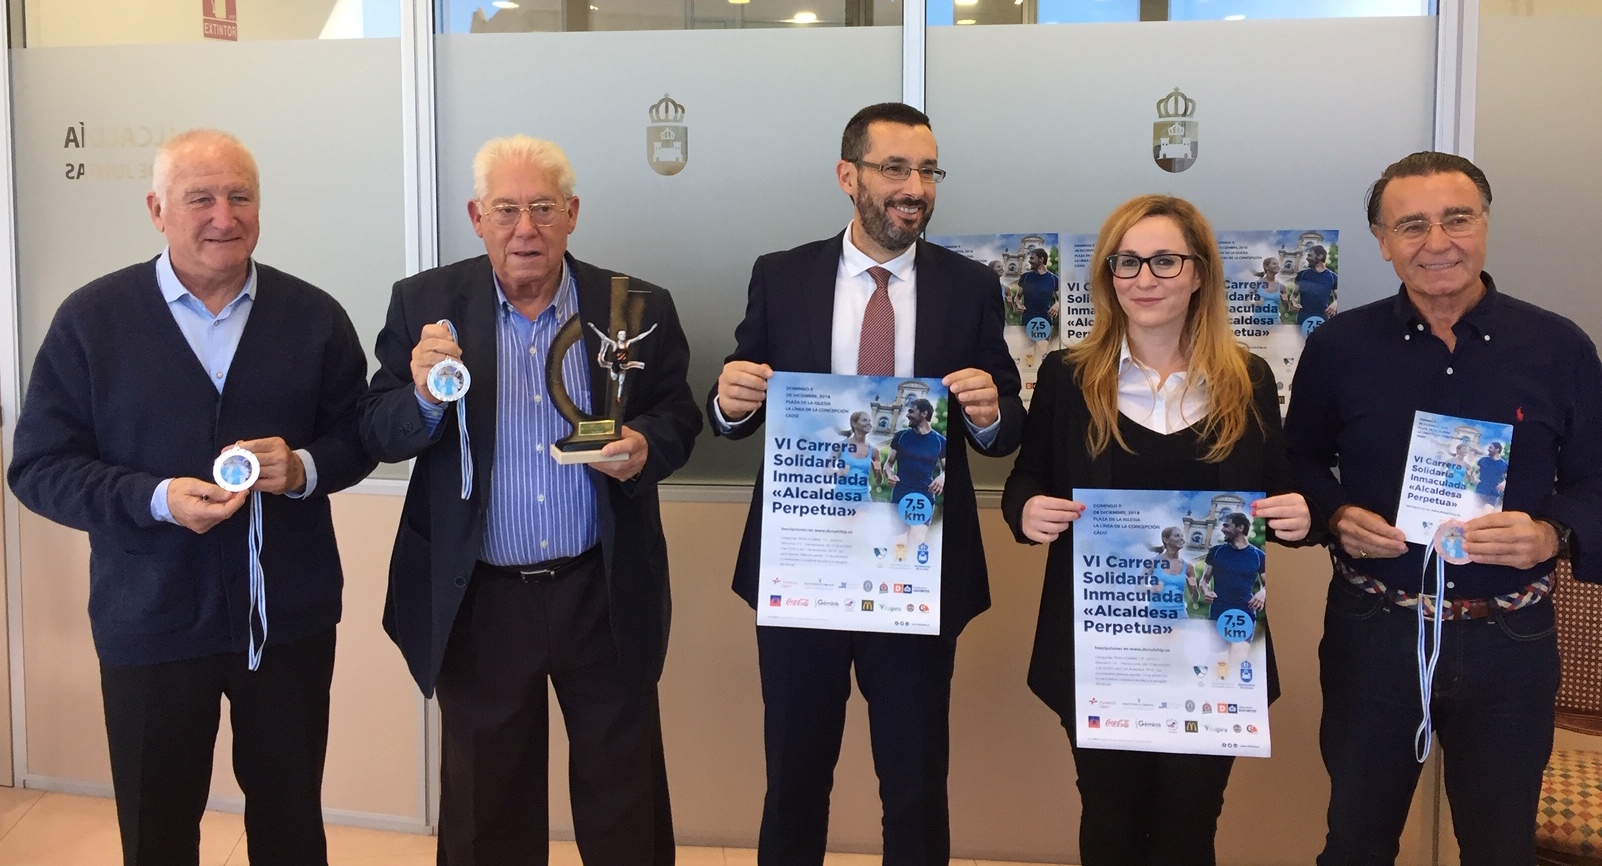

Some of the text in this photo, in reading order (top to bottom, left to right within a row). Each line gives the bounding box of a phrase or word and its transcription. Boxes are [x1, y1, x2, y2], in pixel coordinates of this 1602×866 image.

[204, 22, 237, 37] EXTINTOR
[1067, 282, 1080, 291] VI
[1031, 322, 1046, 330] 7,5
[775, 438, 857, 453] VI Carrera
[774, 454, 846, 469] Solidaria
[1426, 458, 1462, 470] Carrera
[774, 470, 867, 486] Inmaculada
[1412, 465, 1454, 478] Solidaria
[1411, 474, 1466, 490] Inmaculada
[772, 487, 862, 502] «Alcaldesa
[1409, 484, 1462, 498] «Alcaldesa
[905, 498, 925, 511] 7,5
[1408, 492, 1458, 507] Perpetua»
[772, 502, 856, 517] Perpetua»
[905, 510, 925, 521] km
[1083, 555, 1170, 569] VI Carrera
[1083, 572, 1159, 586] Solidaria
[1084, 588, 1184, 604] Inmaculada
[1084, 605, 1178, 619] «Alcaldesa
[1084, 620, 1173, 635] Perpetua»
[1224, 615, 1246, 627] 7,5
[1224, 628, 1246, 638] km
